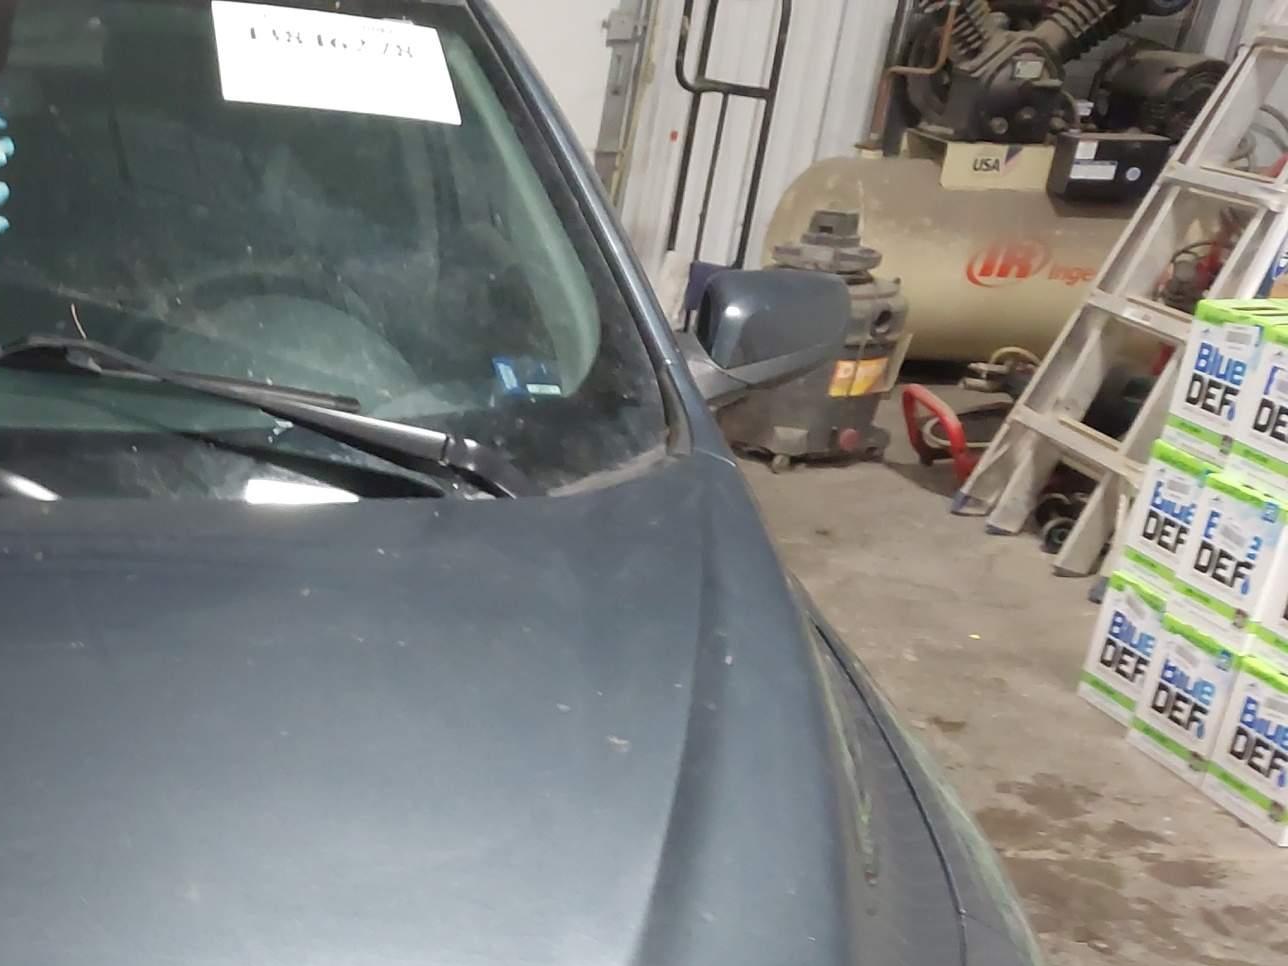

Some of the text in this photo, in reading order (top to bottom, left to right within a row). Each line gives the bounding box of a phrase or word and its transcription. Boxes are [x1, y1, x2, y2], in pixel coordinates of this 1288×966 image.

[972, 158, 1001, 171] USA
[978, 244, 1033, 278] IR
[1185, 373, 1240, 416] DEF
[1142, 509, 1190, 554] DEF
[1193, 540, 1255, 588] DEF
[1100, 638, 1150, 683] DEF
[1151, 682, 1210, 731] DEF
